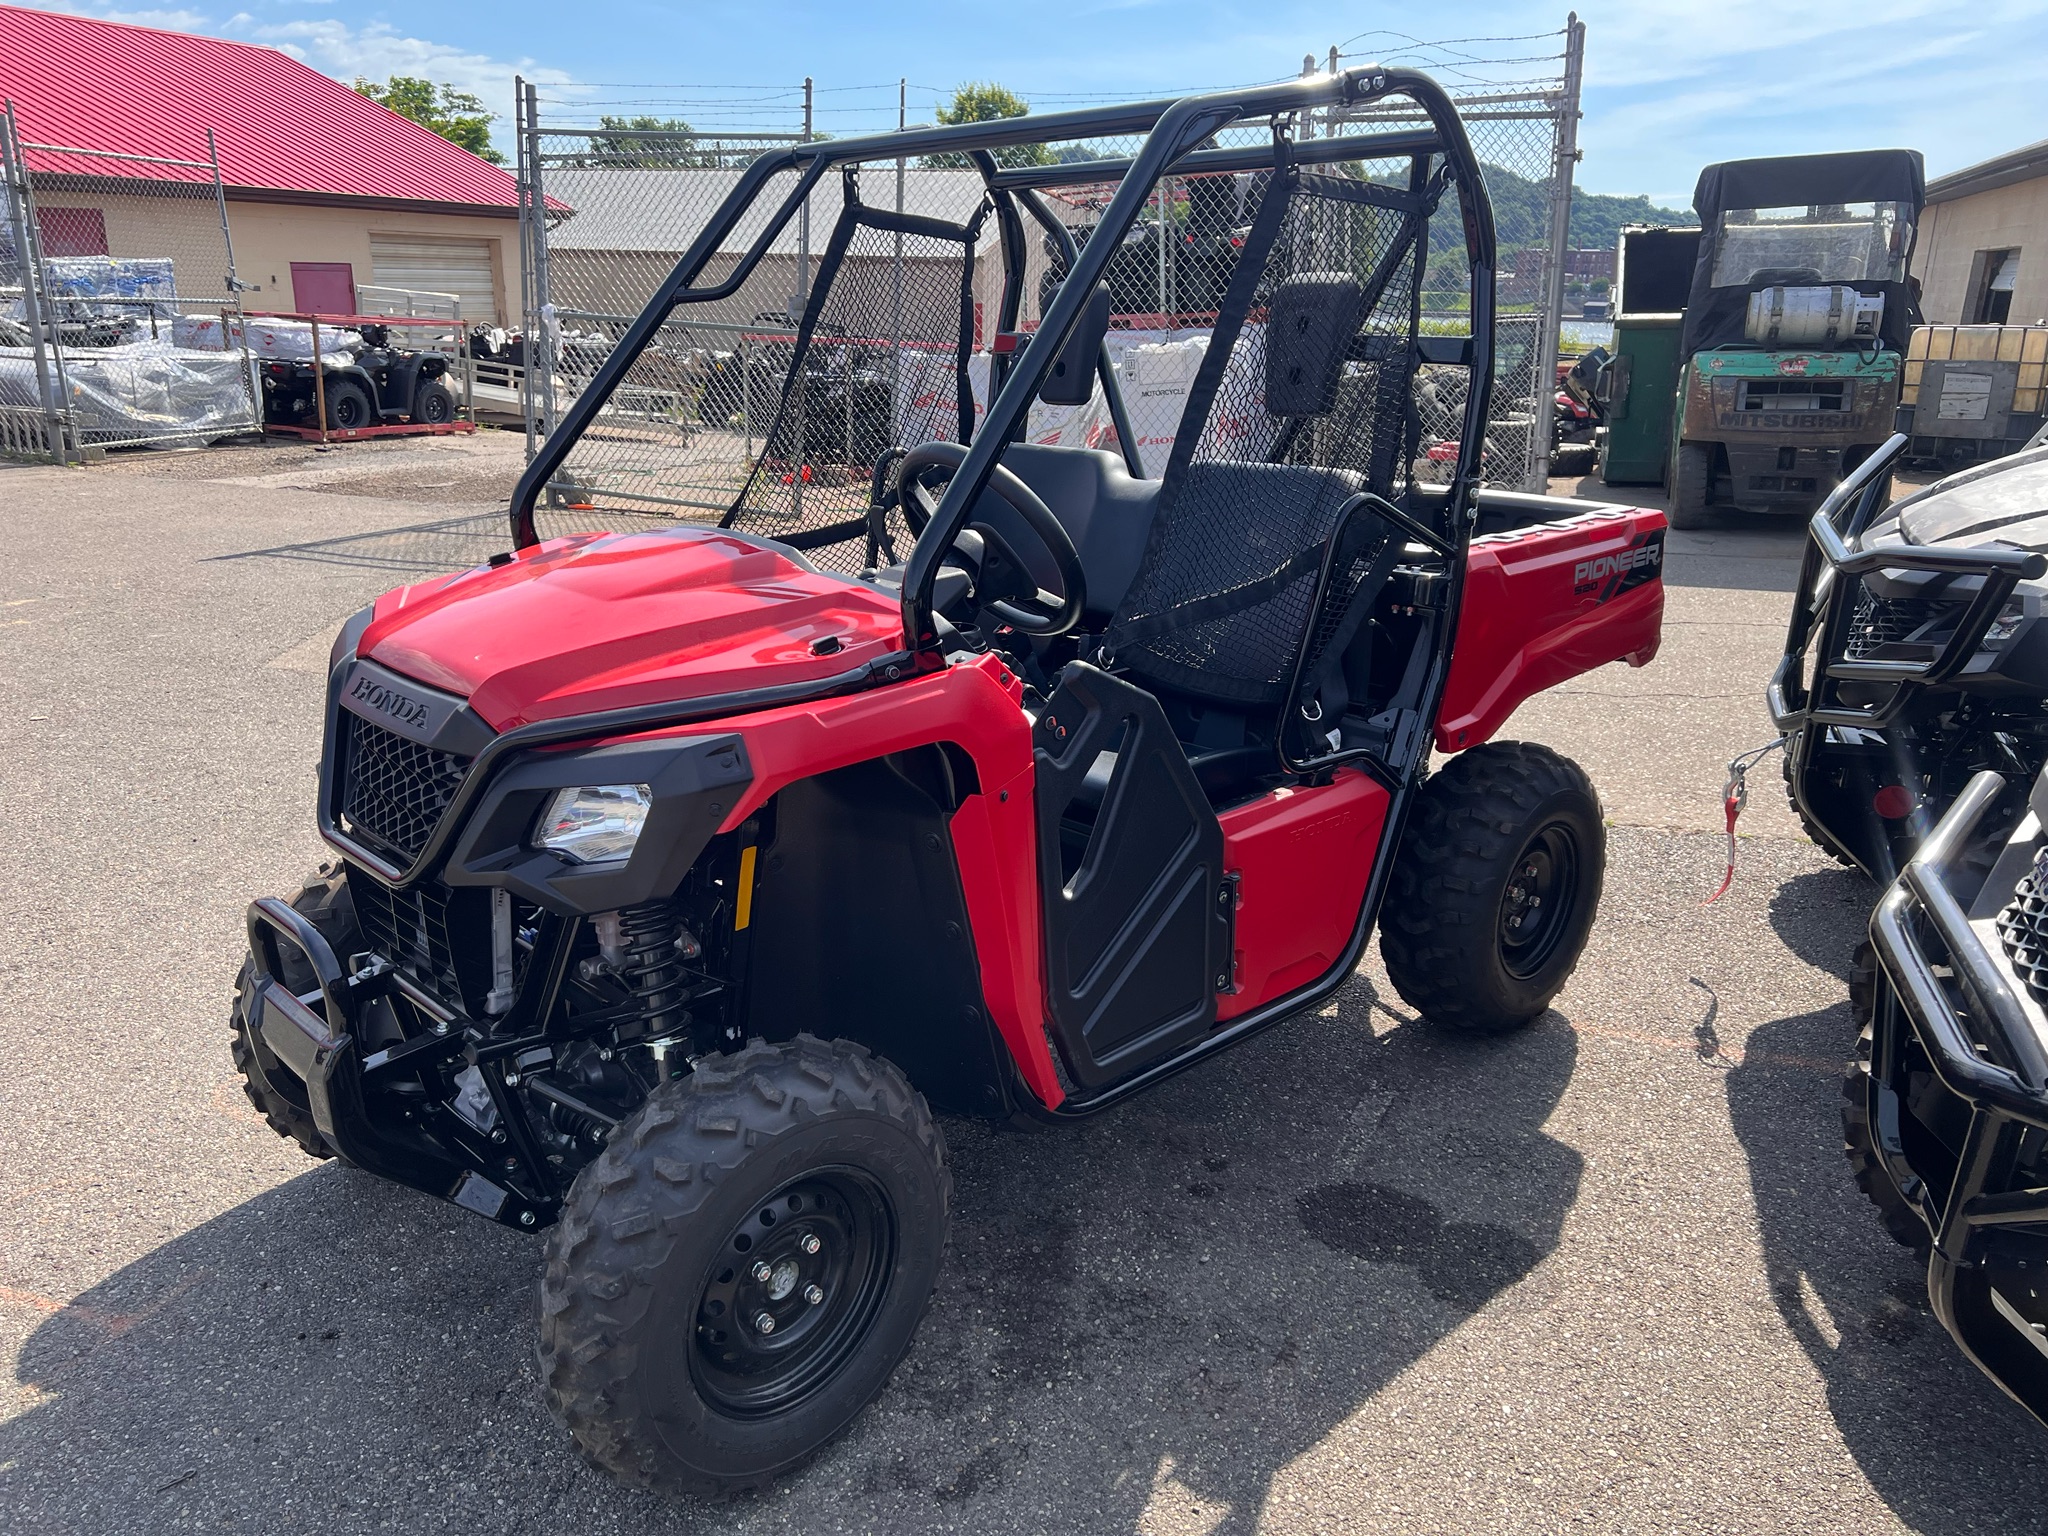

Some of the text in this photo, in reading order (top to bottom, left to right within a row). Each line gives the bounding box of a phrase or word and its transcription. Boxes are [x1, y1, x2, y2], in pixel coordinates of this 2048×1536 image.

[1141, 388, 1186, 398] MOTORCYCLE
[1720, 412, 1863, 429] MITSUBISHI
[1149, 436, 1176, 445] HON
[1574, 543, 1660, 585] PIONEER
[1574, 581, 1598, 595] 520
[351, 677, 430, 729] HONDA
[1289, 811, 1357, 843] HONDA
[773, 1134, 921, 1194] MAXXIS
